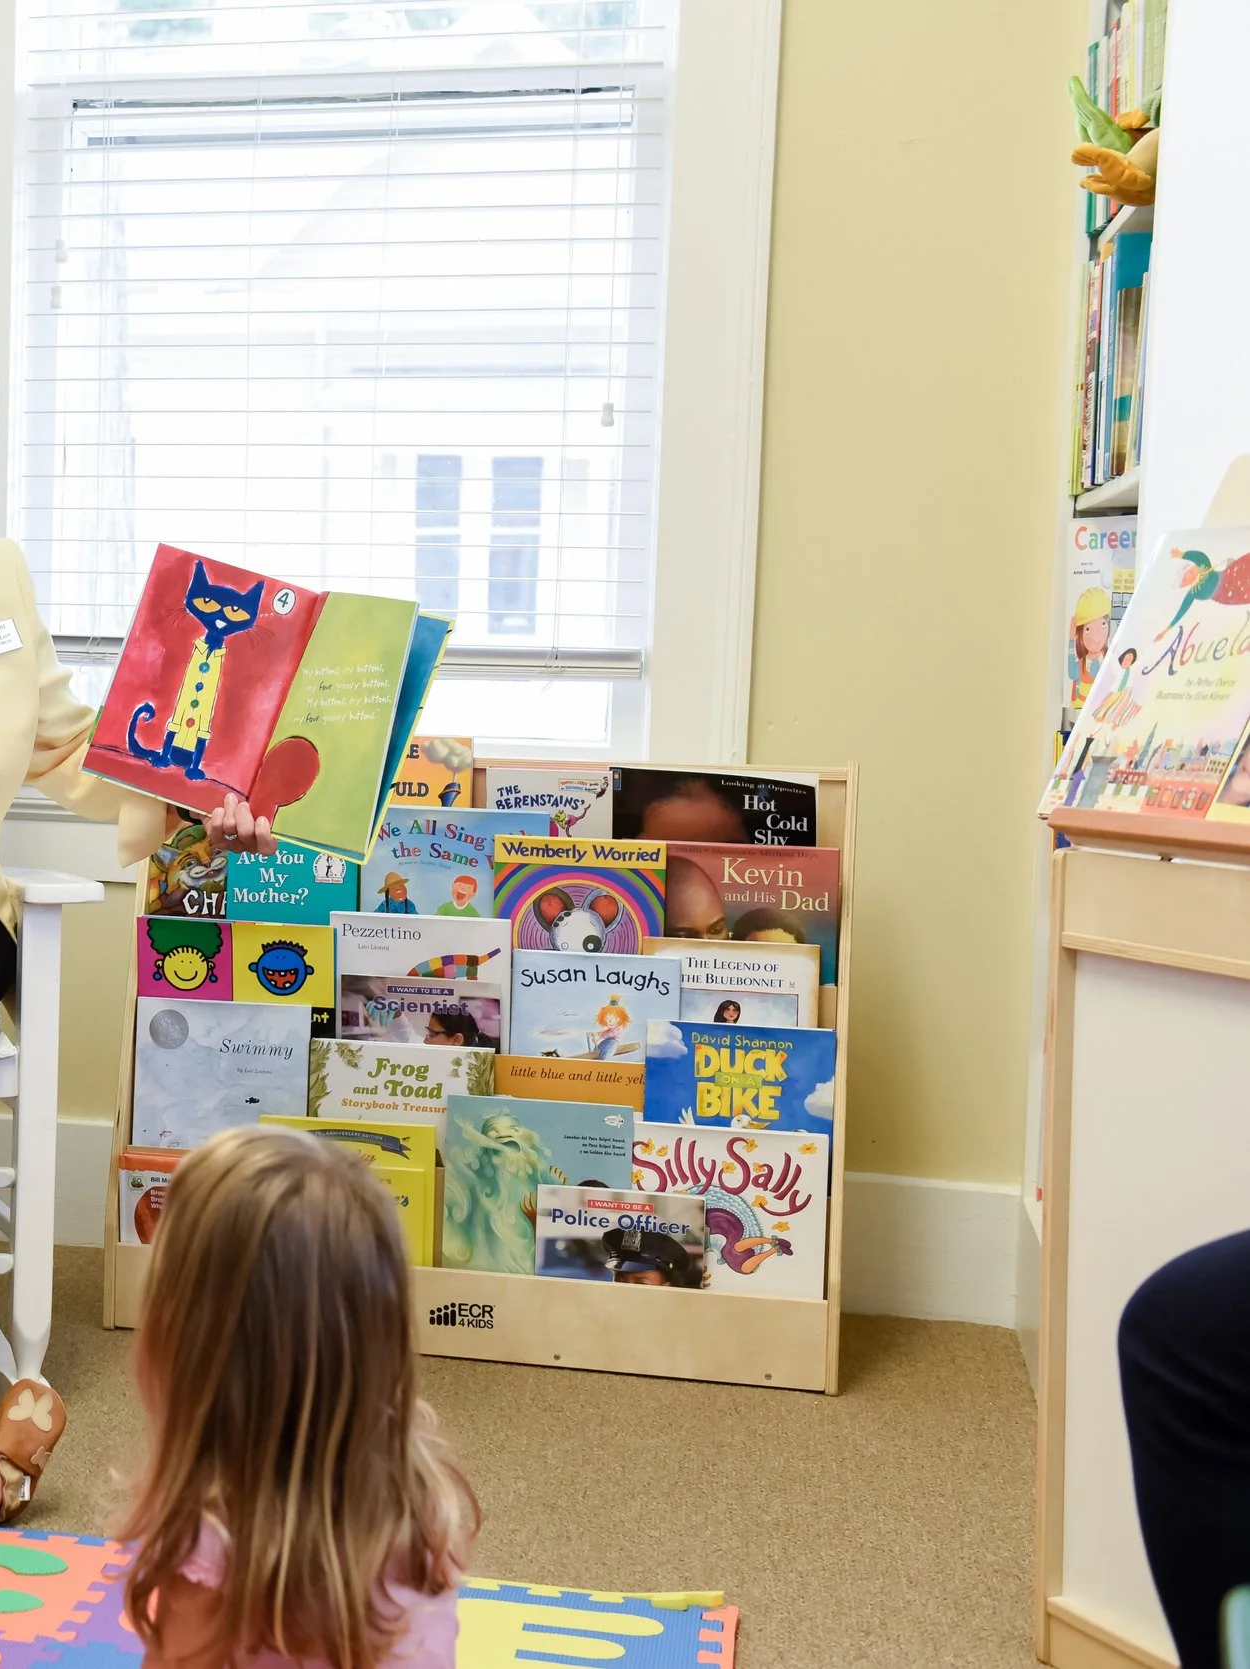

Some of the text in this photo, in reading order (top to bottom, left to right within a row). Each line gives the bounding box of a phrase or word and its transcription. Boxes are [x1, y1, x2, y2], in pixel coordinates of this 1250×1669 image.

[1074, 525, 1138, 551] Career
[277, 592, 289, 608] 4
[318, 680, 333, 691] four
[305, 712, 320, 723] four
[497, 785, 521, 797] THE
[721, 779, 755, 789] Looking
[768, 784, 807, 795] Opposites
[495, 794, 585, 810] BERENSTAINS'
[743, 794, 778, 812] Hot
[766, 814, 808, 832] Cold
[377, 819, 487, 852] We All Sing
[754, 829, 789, 846] Shy
[236, 850, 305, 865] Are You
[391, 841, 422, 859] the
[429, 842, 479, 867] Same
[502, 842, 587, 863] Wemberly
[592, 845, 661, 863] Worried
[259, 868, 289, 887] My
[721, 857, 805, 887] Kevin
[233, 887, 309, 906] Mother?
[724, 889, 830, 912] and His Dad
[342, 923, 422, 941] Pezzettino
[685, 956, 779, 973] THE LEGEND OF
[520, 964, 671, 996] Susan Laughs
[705, 972, 785, 989] BLUEBONNET
[373, 995, 470, 1016] Scientist
[219, 1038, 294, 1060] Swimmy
[691, 1032, 794, 1050] David Shannon
[367, 1057, 430, 1082] Frog
[694, 1043, 789, 1083] DUCK
[510, 1065, 623, 1085] little blue and little
[721, 1074, 739, 1086] ON
[352, 1079, 443, 1100] and Toad
[340, 1097, 399, 1111] Storybook
[695, 1081, 783, 1120] BIKE
[632, 1136, 813, 1216] Silly Sally
[594, 1201, 618, 1210] WANT
[632, 1203, 642, 1211] BE
[551, 1208, 691, 1236] Police Officer
[457, 1303, 494, 1319] ECR
[458, 1318, 494, 1329] 4 KIDS
